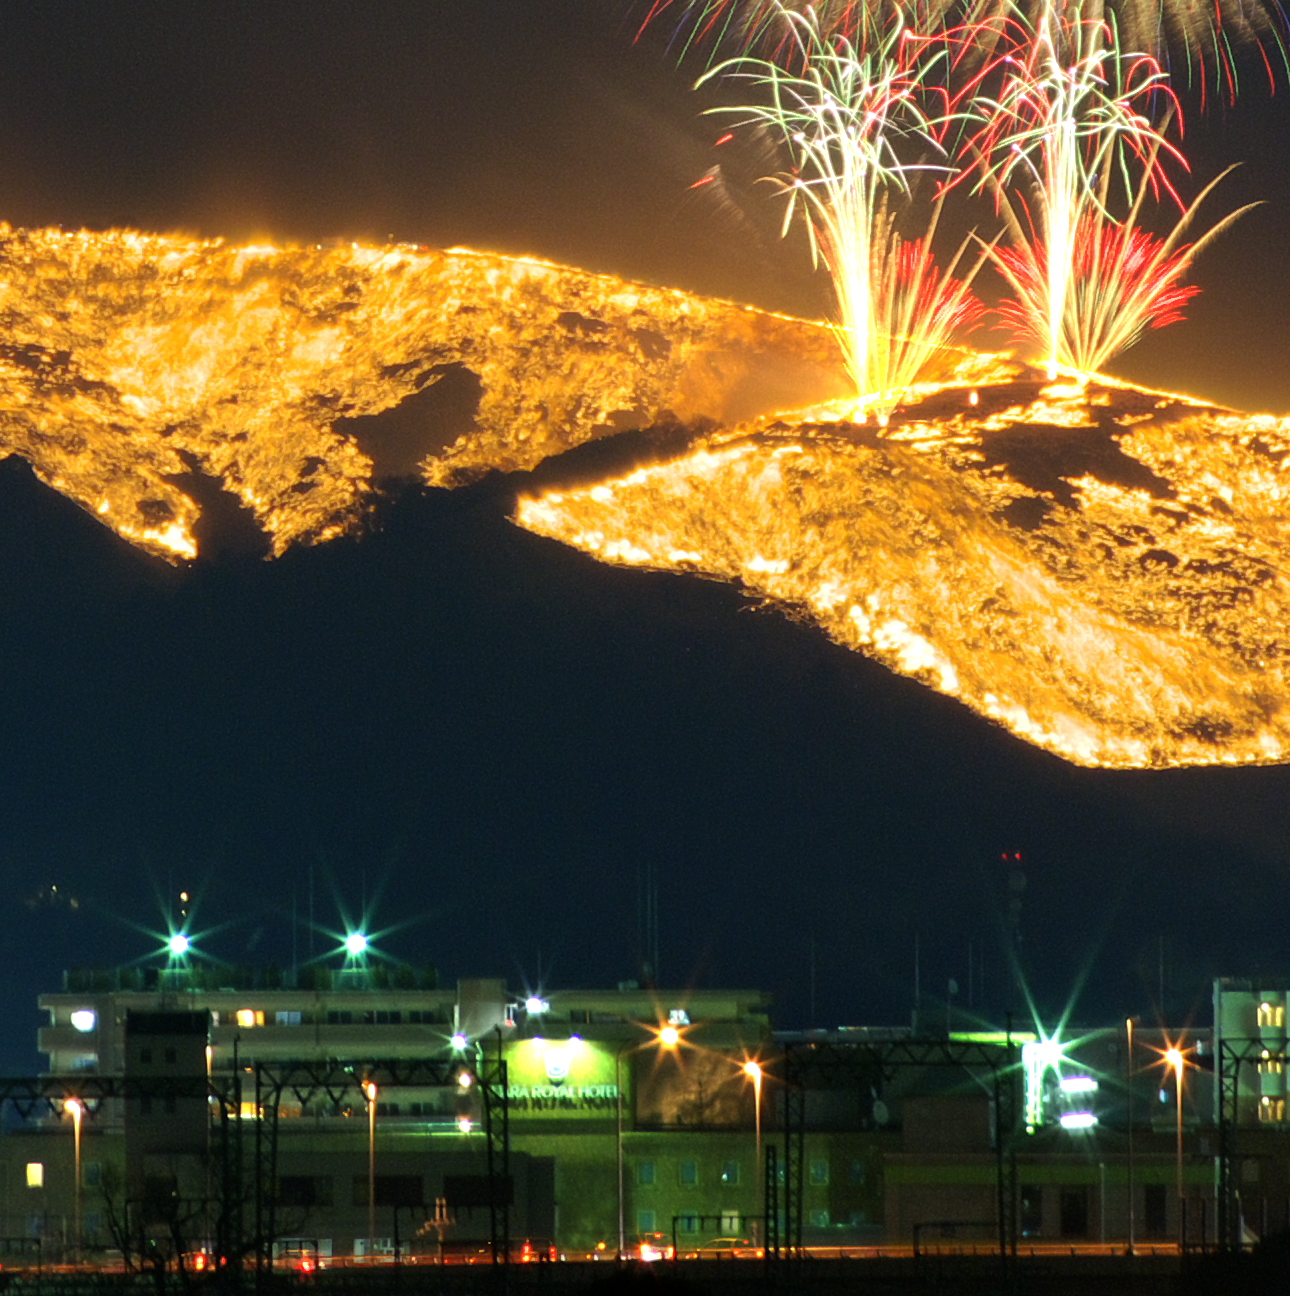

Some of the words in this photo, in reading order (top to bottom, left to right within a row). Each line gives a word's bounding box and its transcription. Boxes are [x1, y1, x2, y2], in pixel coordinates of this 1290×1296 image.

[488, 1084, 530, 1098] NRA
[532, 1084, 574, 1099] ROYAL
[578, 1084, 618, 1099] HOTEL
